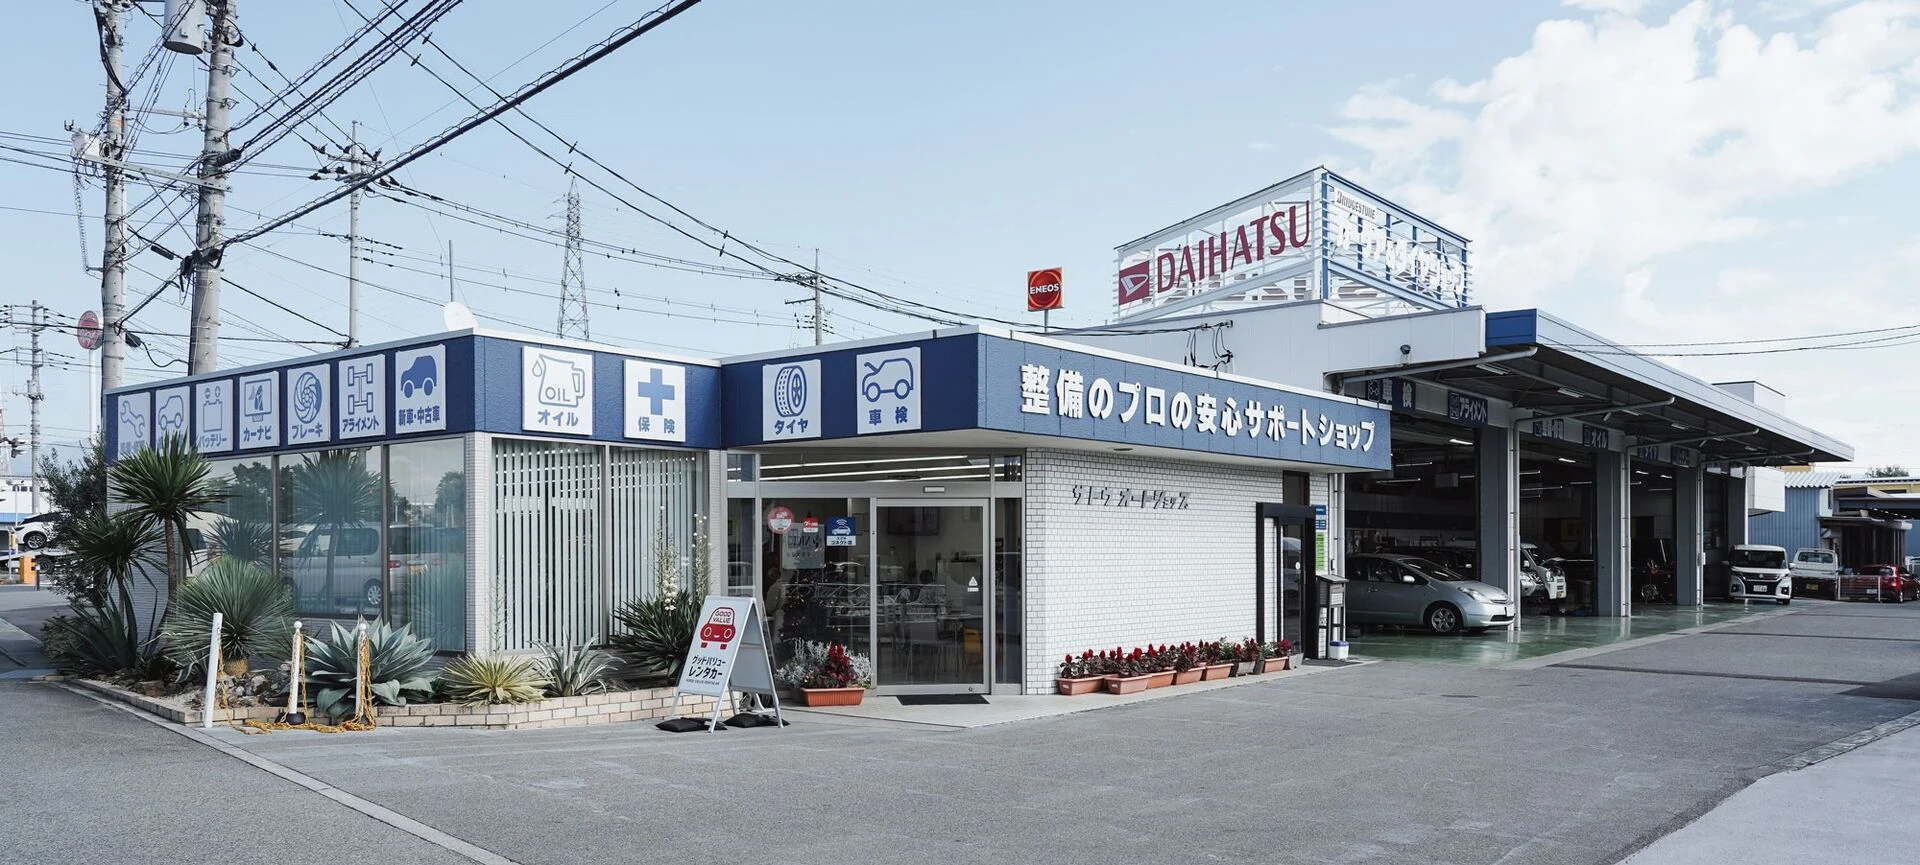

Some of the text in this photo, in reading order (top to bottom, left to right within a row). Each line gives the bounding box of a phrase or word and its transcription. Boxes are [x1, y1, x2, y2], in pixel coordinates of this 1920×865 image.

[1157, 200, 1310, 293] DAIHATSU
[1030, 283, 1060, 295] ENEOS
[545, 386, 571, 402] OIL
[398, 405, 440, 426] 新車・中古車
[868, 406, 908, 426] 車検
[1020, 364, 1375, 452] 整備のプロの安心サポートショップ
[1460, 397, 1487, 423] アライメント
[342, 415, 379, 432] アライメント
[537, 409, 579, 427] オイル
[638, 416, 676, 434] 保険
[774, 418, 809, 435] タイヤ
[243, 425, 272, 442] カーナビ
[291, 422, 323, 439] ブレーキ
[692, 655, 726, 667] グッドバリュー
[688, 667, 723, 679] レンタカー
